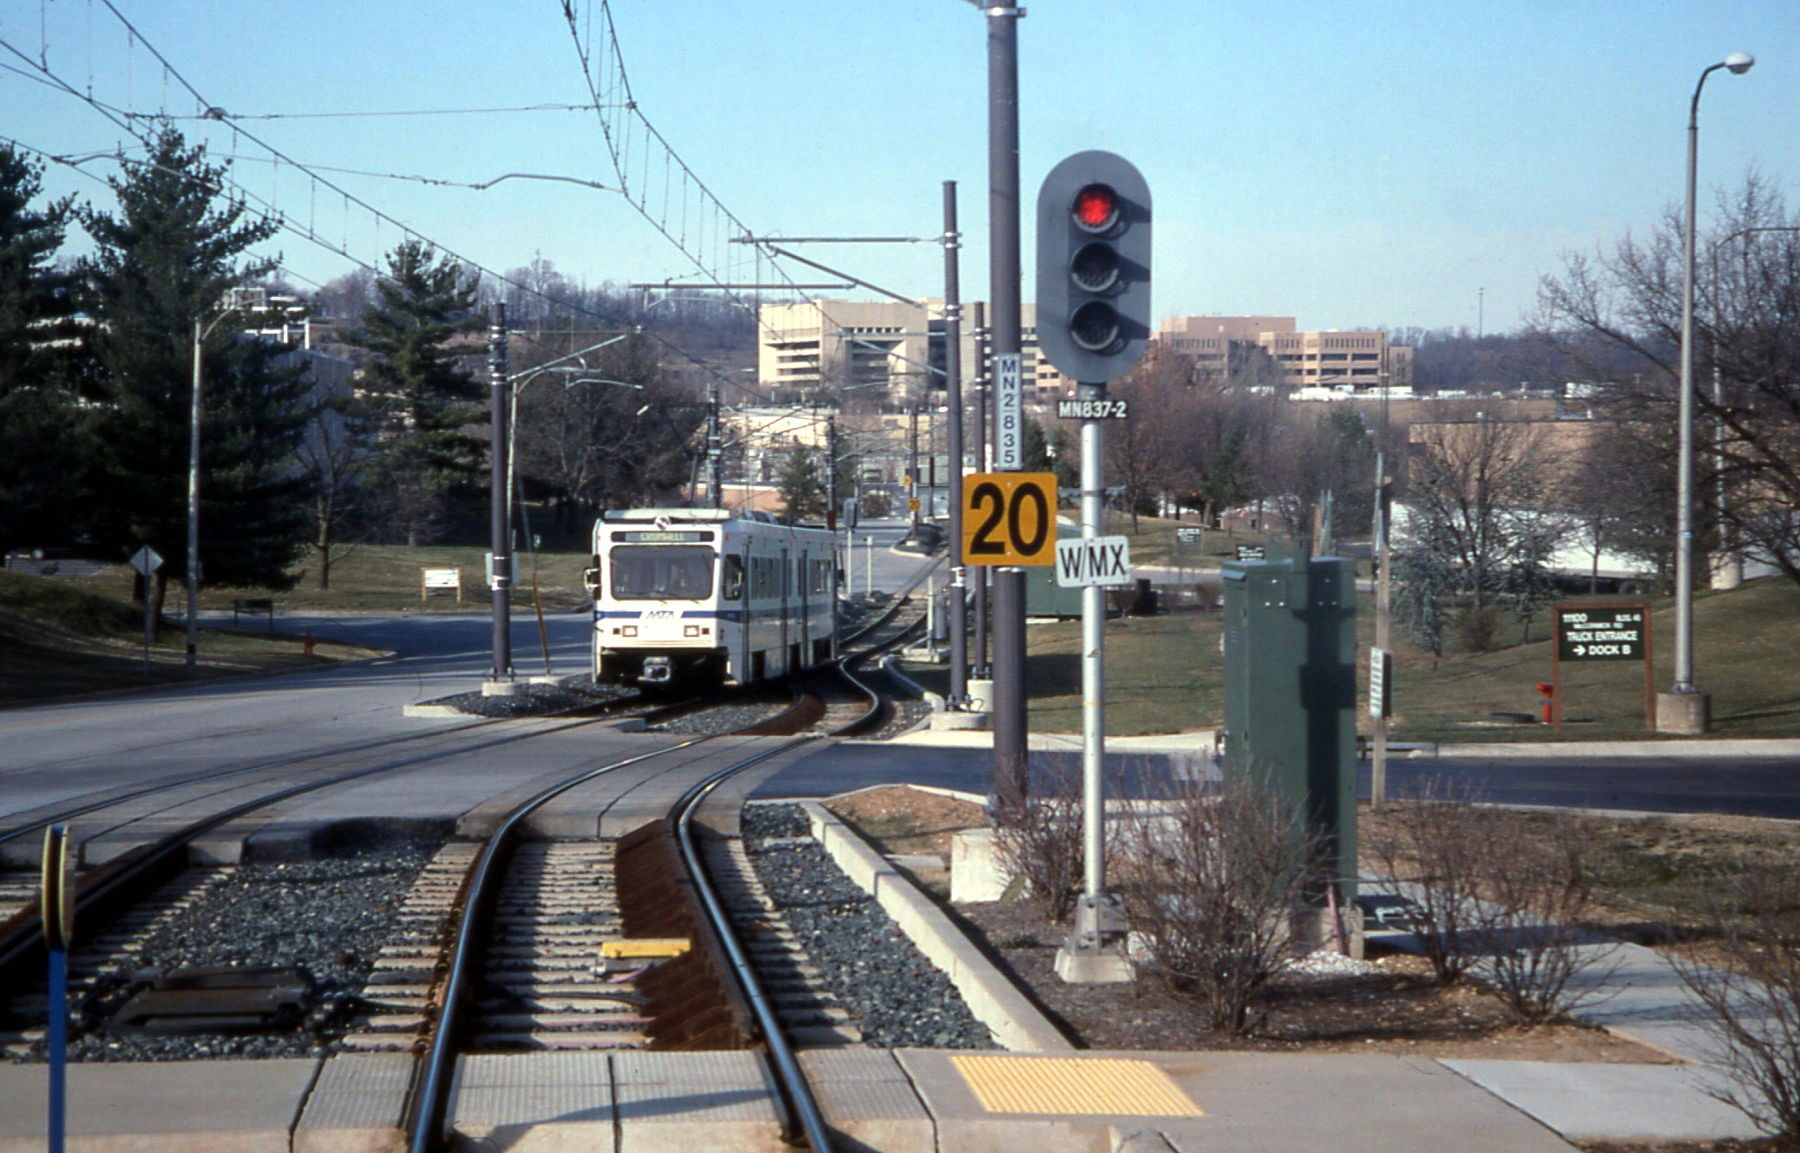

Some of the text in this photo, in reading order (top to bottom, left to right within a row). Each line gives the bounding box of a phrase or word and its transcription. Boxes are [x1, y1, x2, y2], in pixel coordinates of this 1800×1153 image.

[1002, 359, 1016, 464] MN2835
[1058, 401, 1127, 418] MN837-2
[969, 481, 1049, 557] 20
[1059, 543, 1127, 582] W/MX
[1566, 630, 1638, 641] TRUCK ENTRANCE
[1588, 644, 1631, 655] DOCK B
